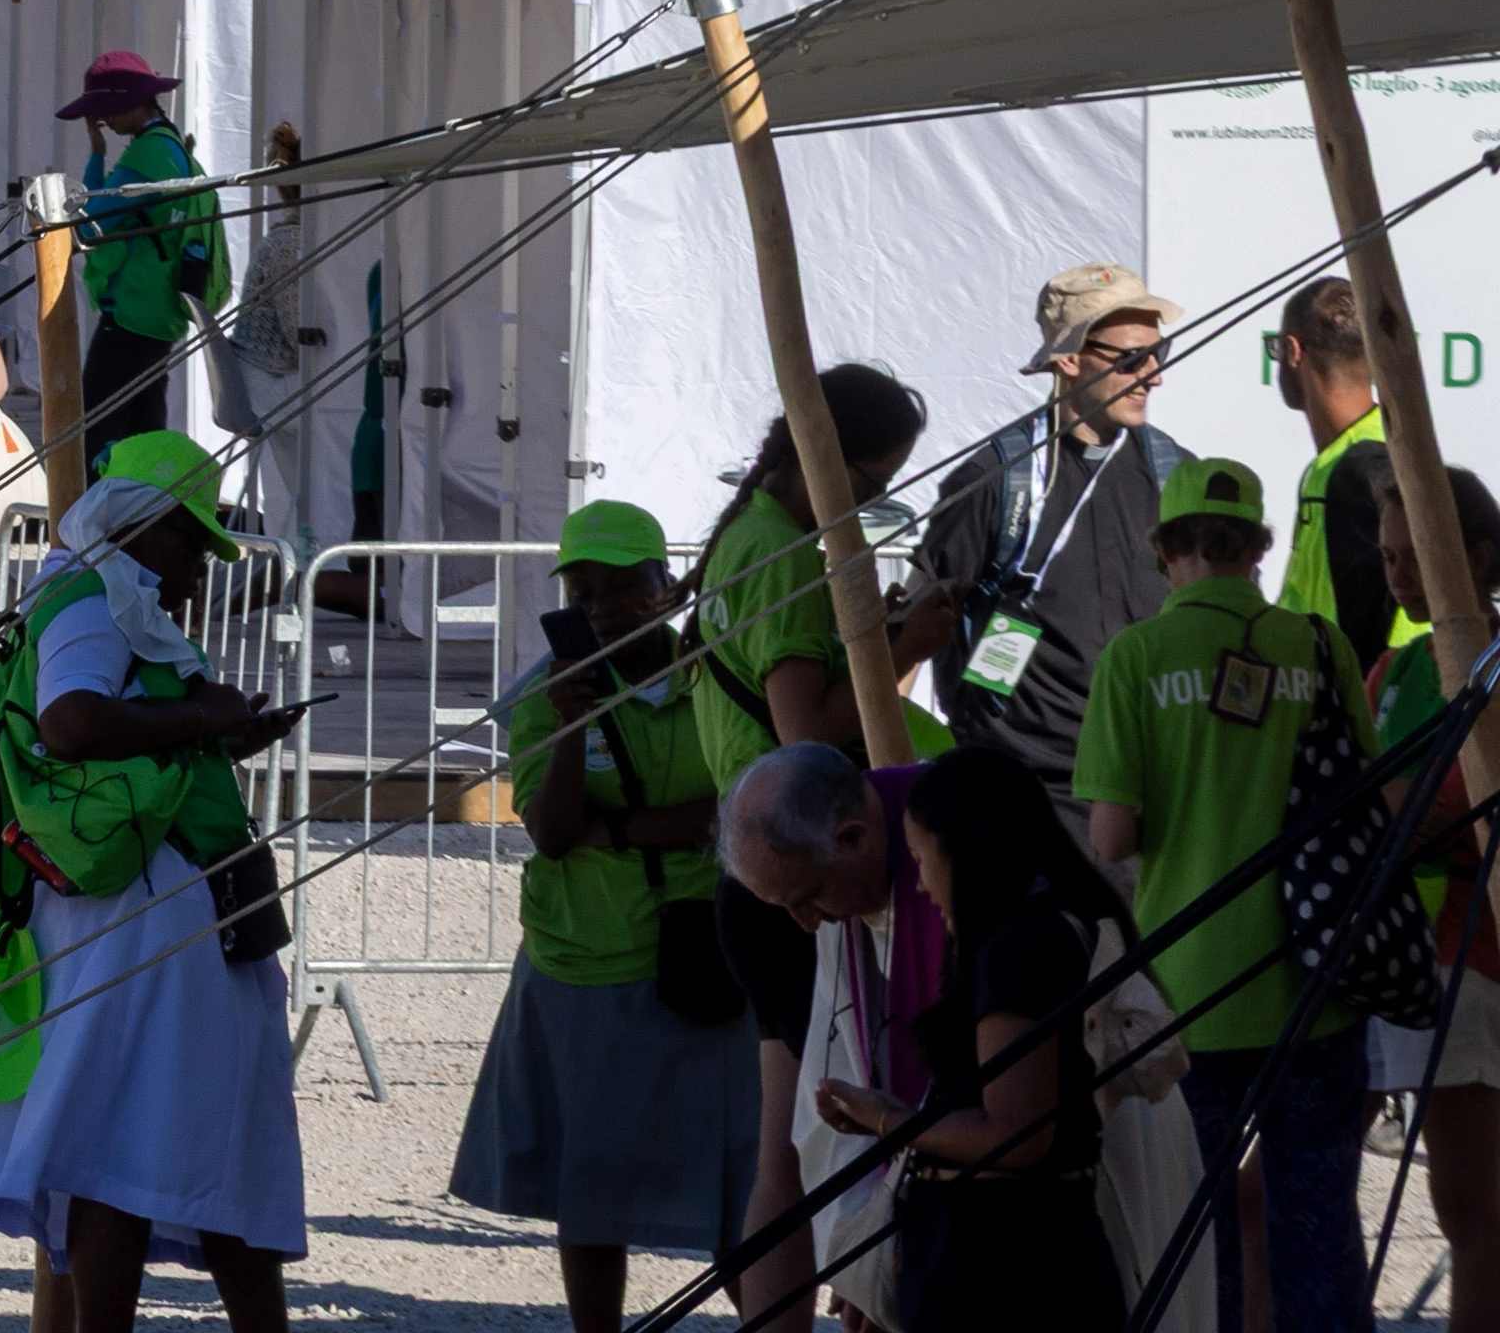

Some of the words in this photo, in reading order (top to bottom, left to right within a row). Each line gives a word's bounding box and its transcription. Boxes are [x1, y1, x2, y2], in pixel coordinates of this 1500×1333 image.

[1365, 74, 1420, 97] luglio
[1434, 76, 1446, 93] 3
[1449, 79, 1500, 99] agost
[1441, 331, 1484, 388] D
